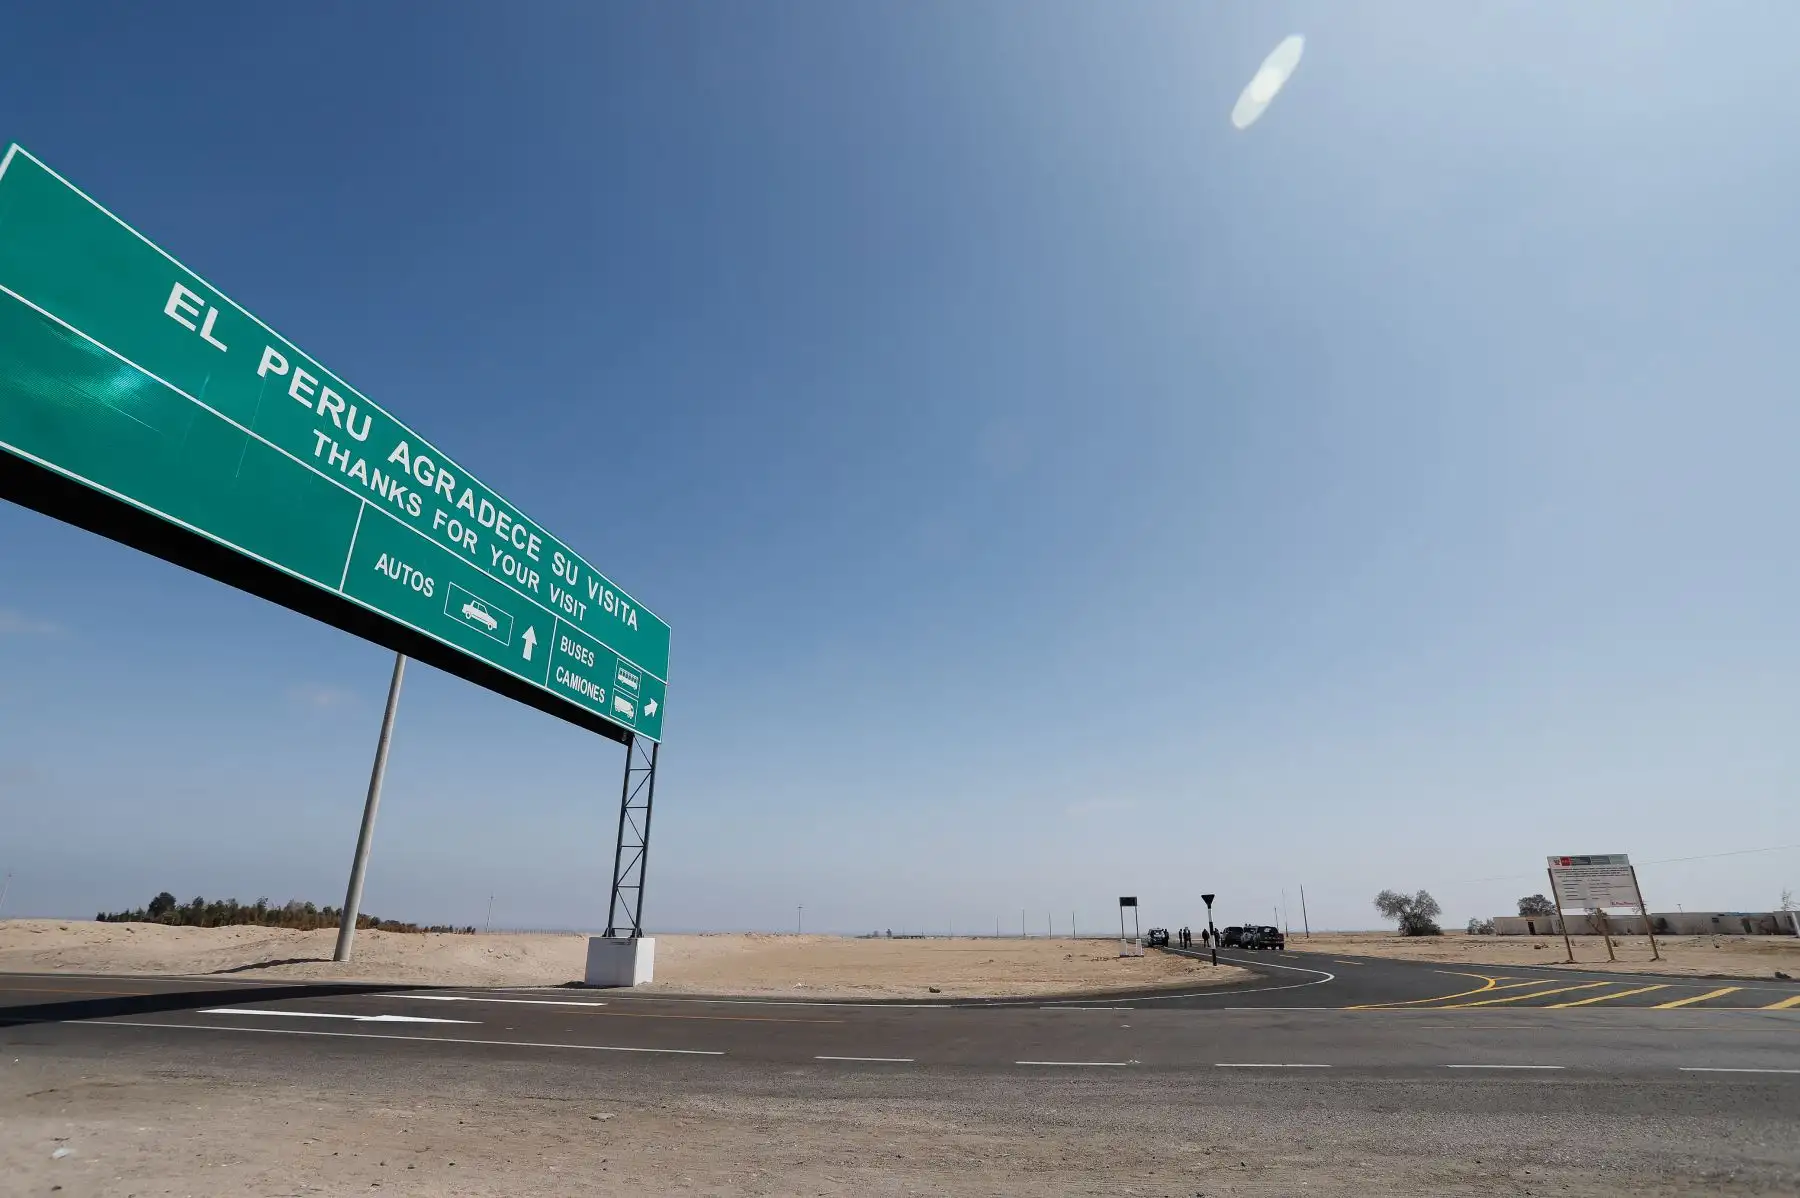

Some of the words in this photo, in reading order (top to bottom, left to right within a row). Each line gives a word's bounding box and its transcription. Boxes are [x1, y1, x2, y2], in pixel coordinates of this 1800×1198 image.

[164, 281, 228, 353] EL
[257, 345, 372, 442] PERU
[387, 440, 542, 562] AGRADECE
[551, 551, 579, 586] SU
[587, 575, 639, 632] VISITA
[313, 428, 423, 517] THANKS
[433, 508, 478, 554] FOR
[490, 543, 540, 593] YOUR
[549, 582, 587, 621] VISIT
[374, 552, 435, 598] AUTOS
[559, 635, 595, 668] BUSES
[555, 665, 606, 704] CAMIONES
